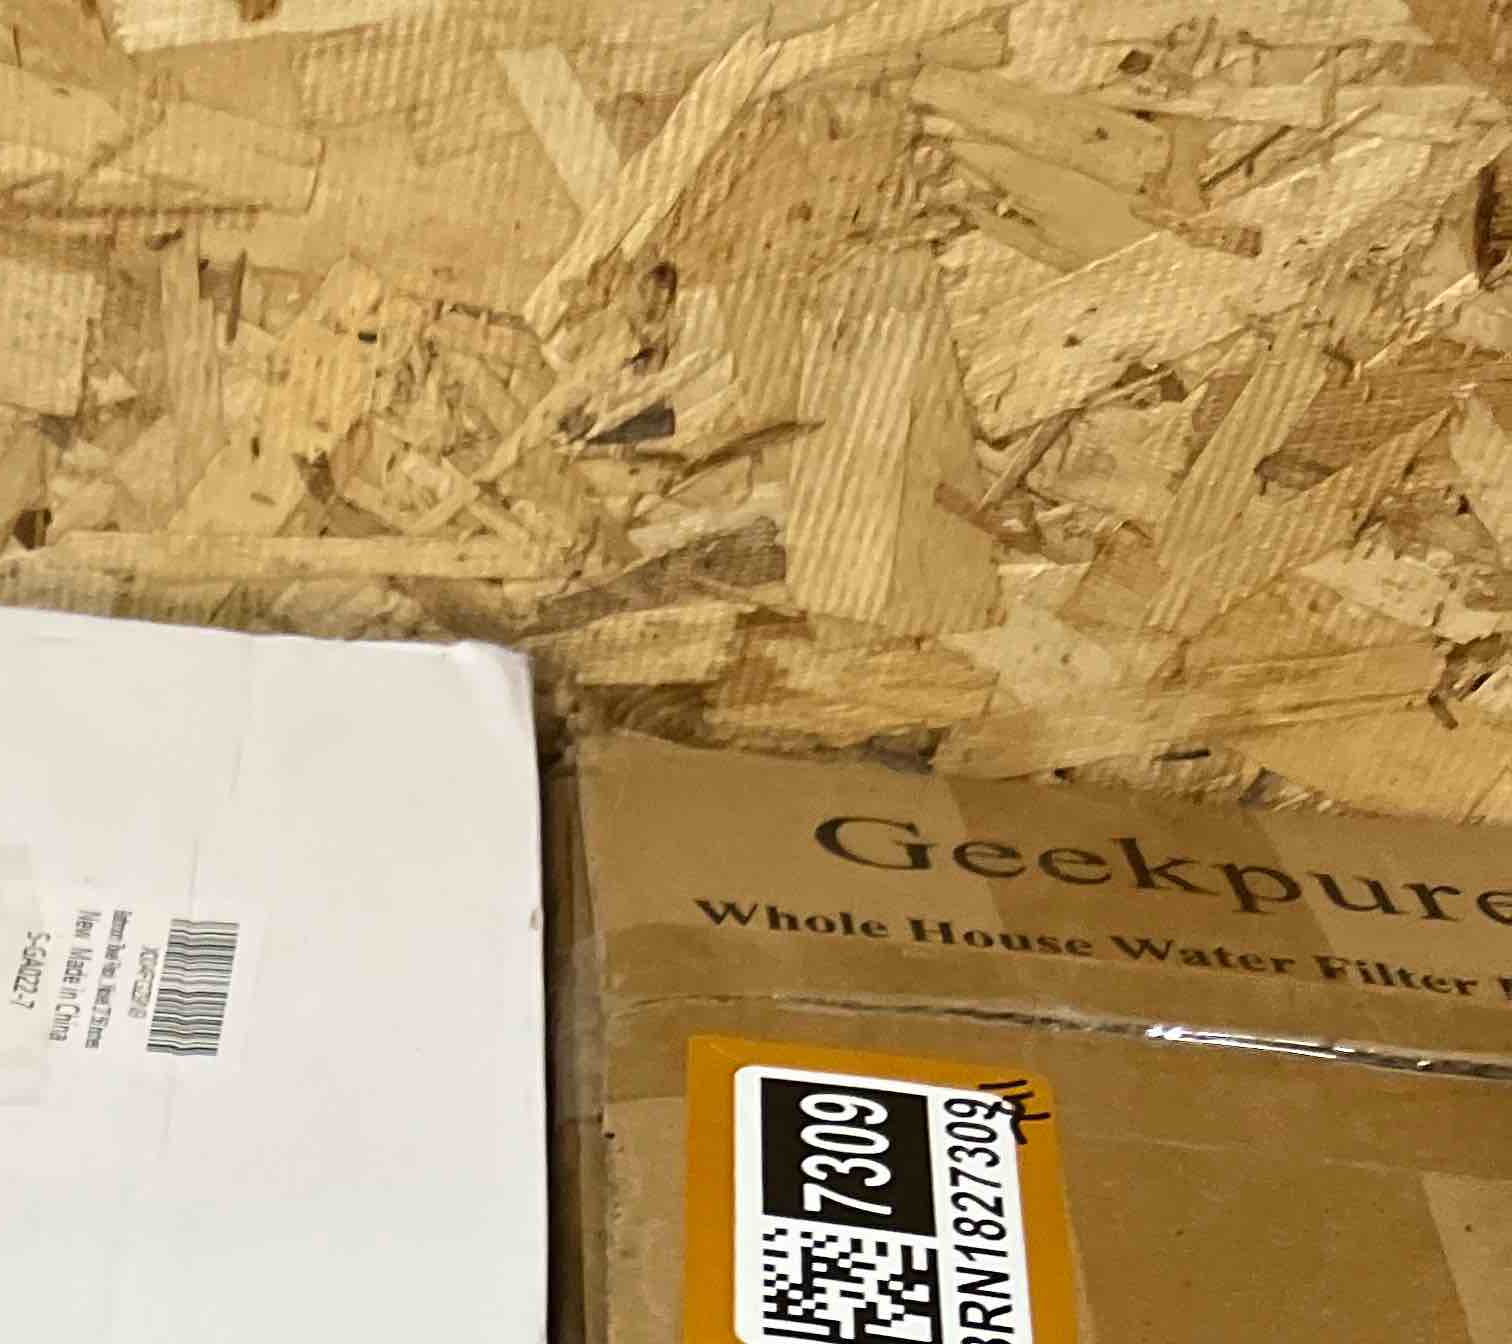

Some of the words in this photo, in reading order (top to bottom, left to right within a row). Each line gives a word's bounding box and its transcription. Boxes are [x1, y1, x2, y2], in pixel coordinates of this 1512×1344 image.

[63, 945, 94, 985] Made
[695, 899, 889, 939] Whole
[905, 917, 1094, 957] House
[1109, 934, 1296, 973] Water
[1311, 954, 1478, 996] Filter
[49, 1002, 81, 1042] China
[799, 1092, 893, 1216] 7309
